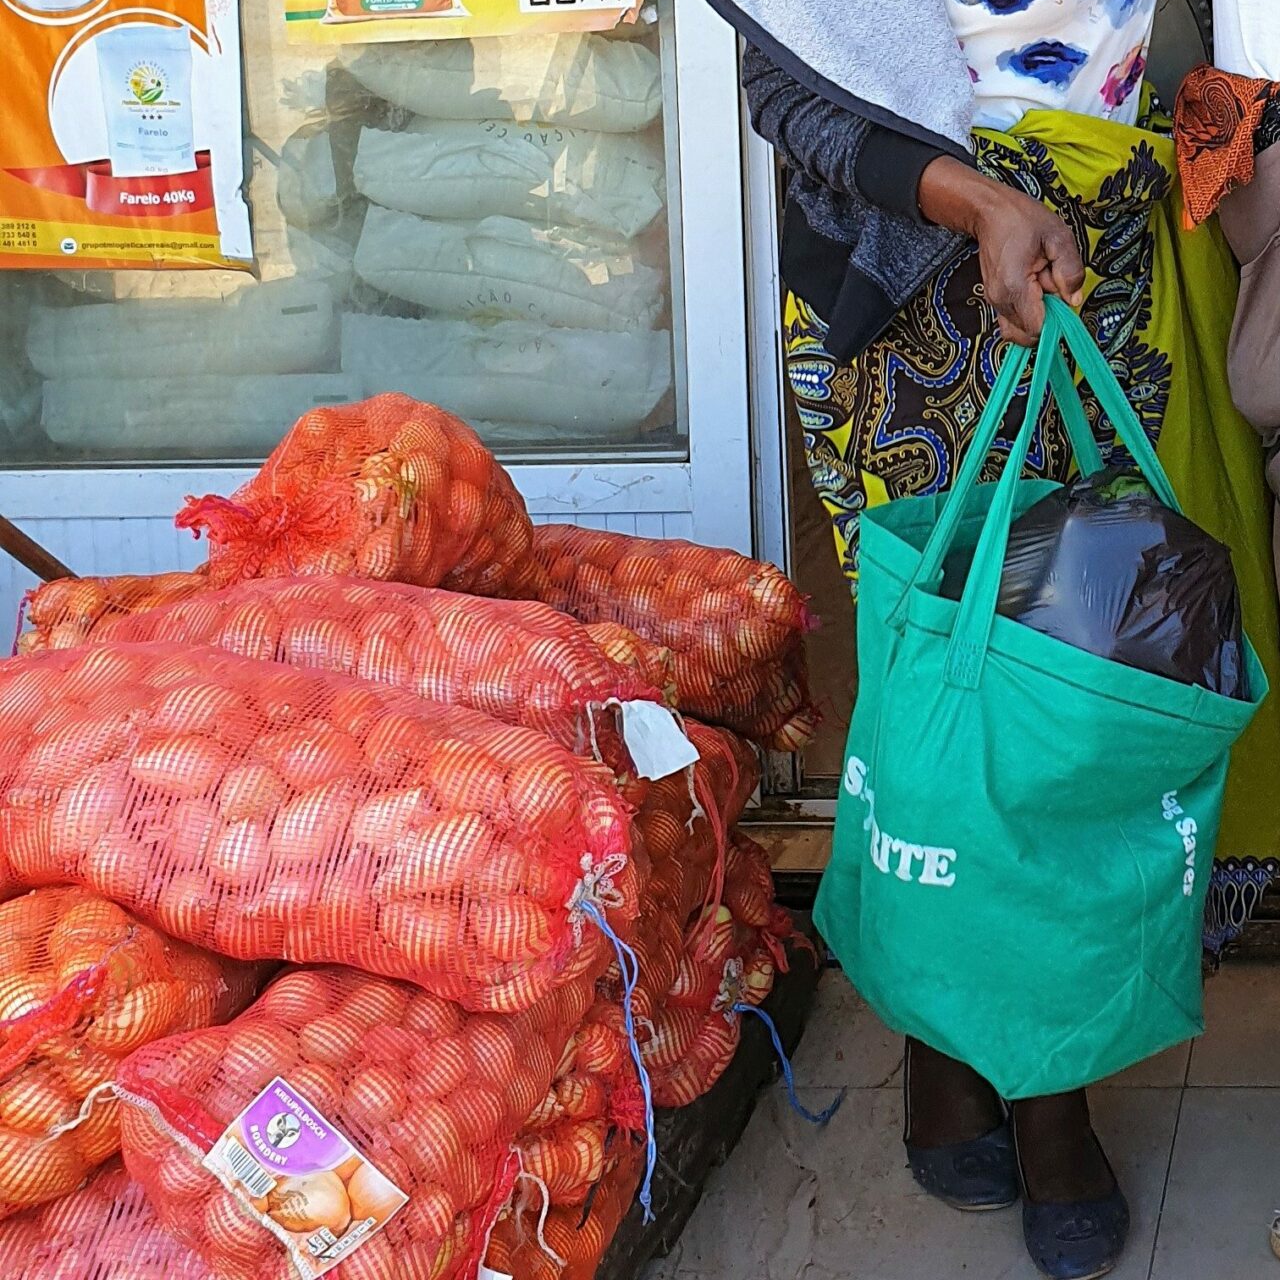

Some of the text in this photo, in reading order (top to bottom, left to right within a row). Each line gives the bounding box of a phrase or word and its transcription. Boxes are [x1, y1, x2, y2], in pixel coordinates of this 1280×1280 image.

[120, 190, 196, 205] Farelo 40Kg
[249, 1124, 288, 1166] BOERDERY
